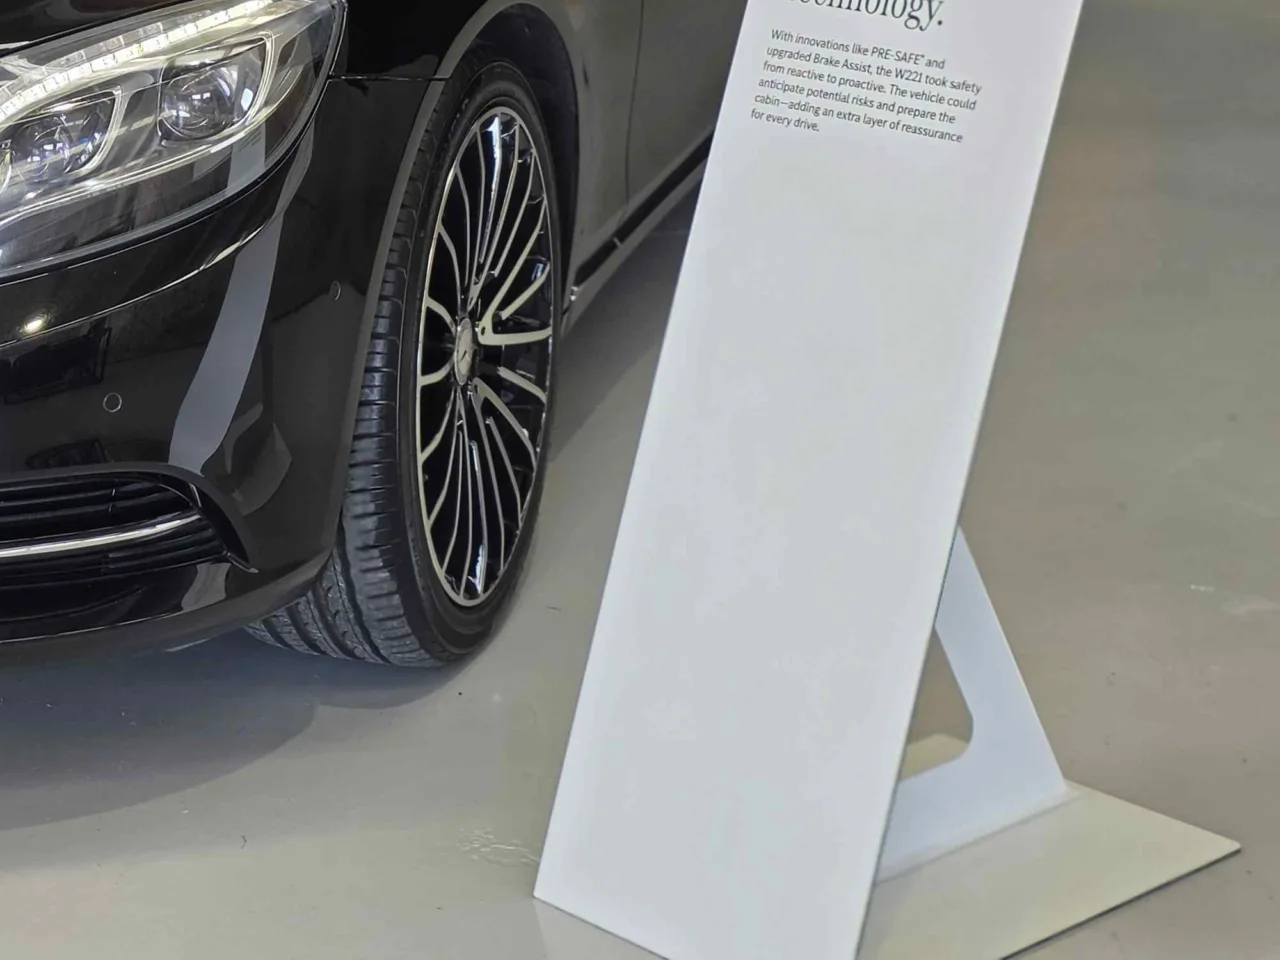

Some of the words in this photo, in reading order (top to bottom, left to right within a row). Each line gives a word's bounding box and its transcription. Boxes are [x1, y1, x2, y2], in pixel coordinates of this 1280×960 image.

[771, 29, 794, 43] With
[795, 33, 850, 53] innovations
[852, 44, 869, 56] like
[925, 57, 945, 69] and
[763, 61, 785, 75] from
[787, 66, 825, 82] reactive
[827, 73, 837, 84] to
[838, 77, 887, 95] proactive.
[890, 84, 908, 97] The
[909, 89, 945, 104] vehicle
[947, 96, 976, 111] could
[766, 47, 811, 63] upgraded
[813, 54, 840, 68] Brake
[842, 59, 874, 75] Assist,
[876, 65, 892, 77] the
[895, 68, 923, 83] W221
[925, 74, 947, 88] took
[949, 79, 982, 95] safety
[751, 108, 765, 121] for
[766, 114, 792, 128] every
[793, 117, 820, 132] drive.
[758, 78, 805, 95] anticipate
[806, 87, 850, 104] potential
[851, 95, 874, 108] risks
[876, 100, 895, 112] and
[897, 106, 936, 122] prepare
[939, 112, 956, 124] the
[822, 108, 834, 118] an
[836, 111, 861, 123] extra
[862, 113, 888, 130] layer
[889, 120, 901, 130] of
[901, 124, 963, 143] reassurance
